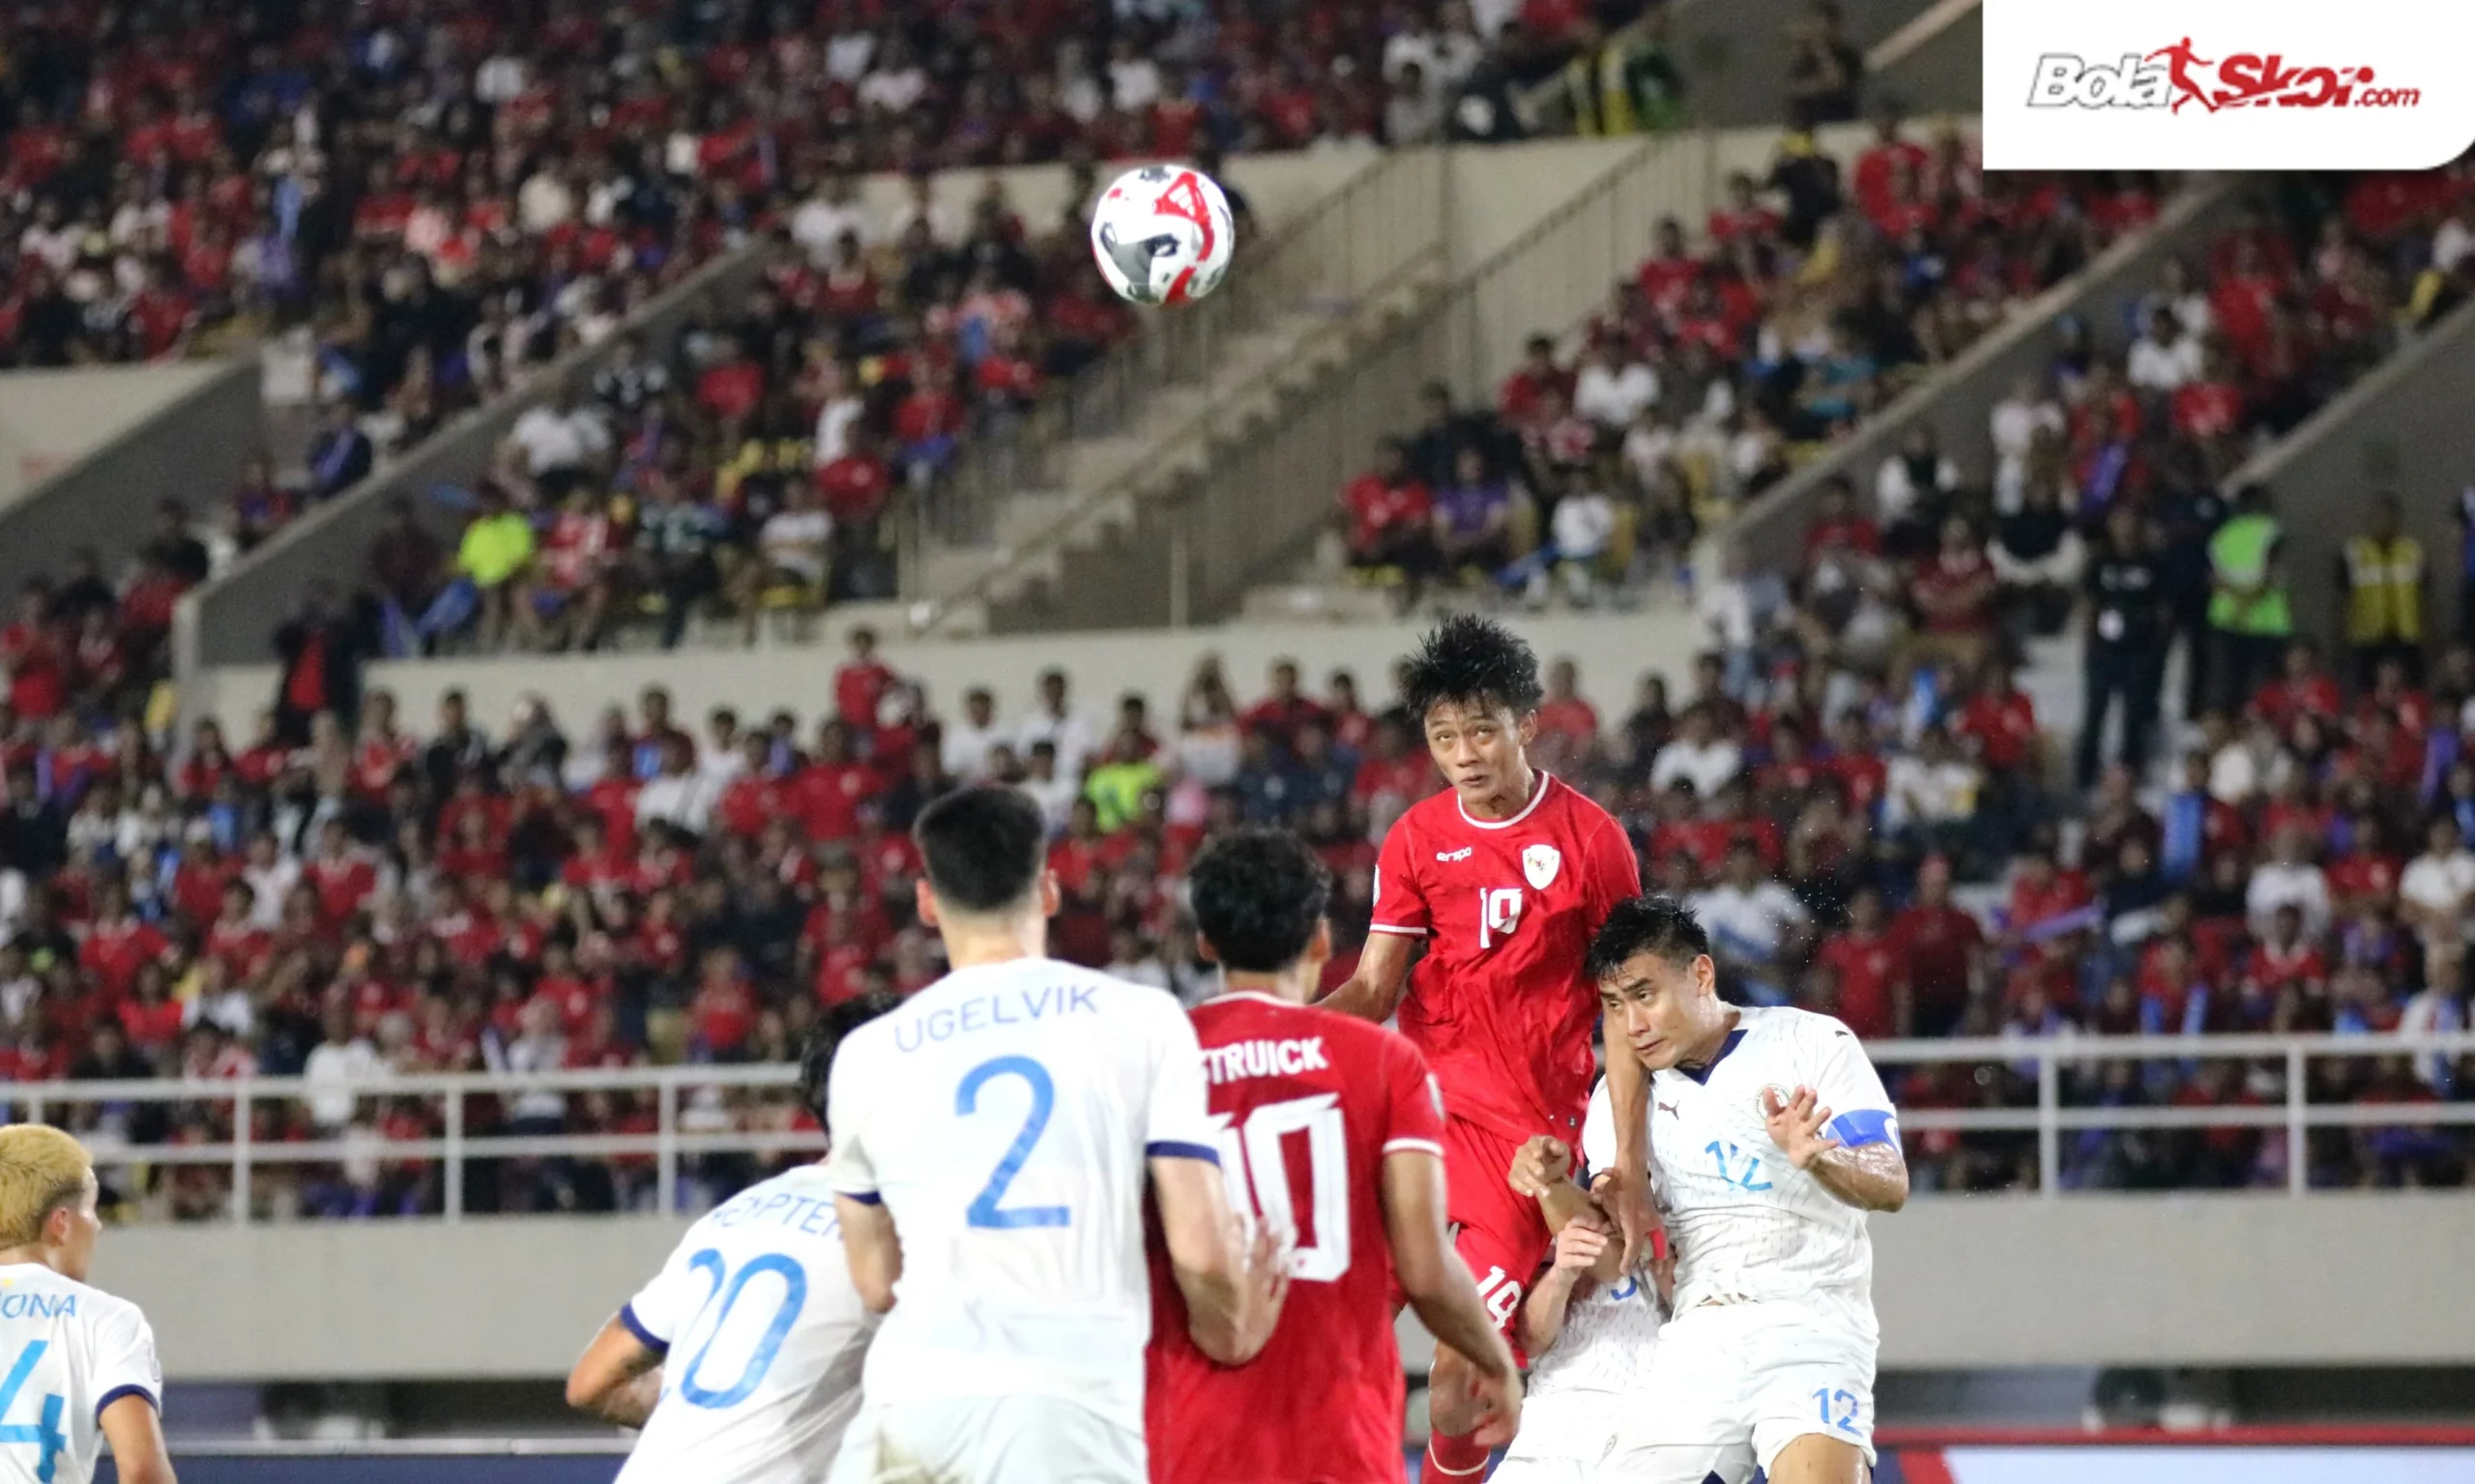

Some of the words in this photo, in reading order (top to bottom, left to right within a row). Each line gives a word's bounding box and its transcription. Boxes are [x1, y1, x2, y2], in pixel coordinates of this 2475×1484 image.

[1436, 847, 1472, 862] erspo
[1479, 887, 1523, 949] 19
[894, 985, 1101, 1054] UGELVIK
[954, 1054, 1072, 1230] 2
[1703, 1141, 1773, 1192] 12
[0, 1292, 76, 1319] ONA
[1811, 1386, 1865, 1439] 12
